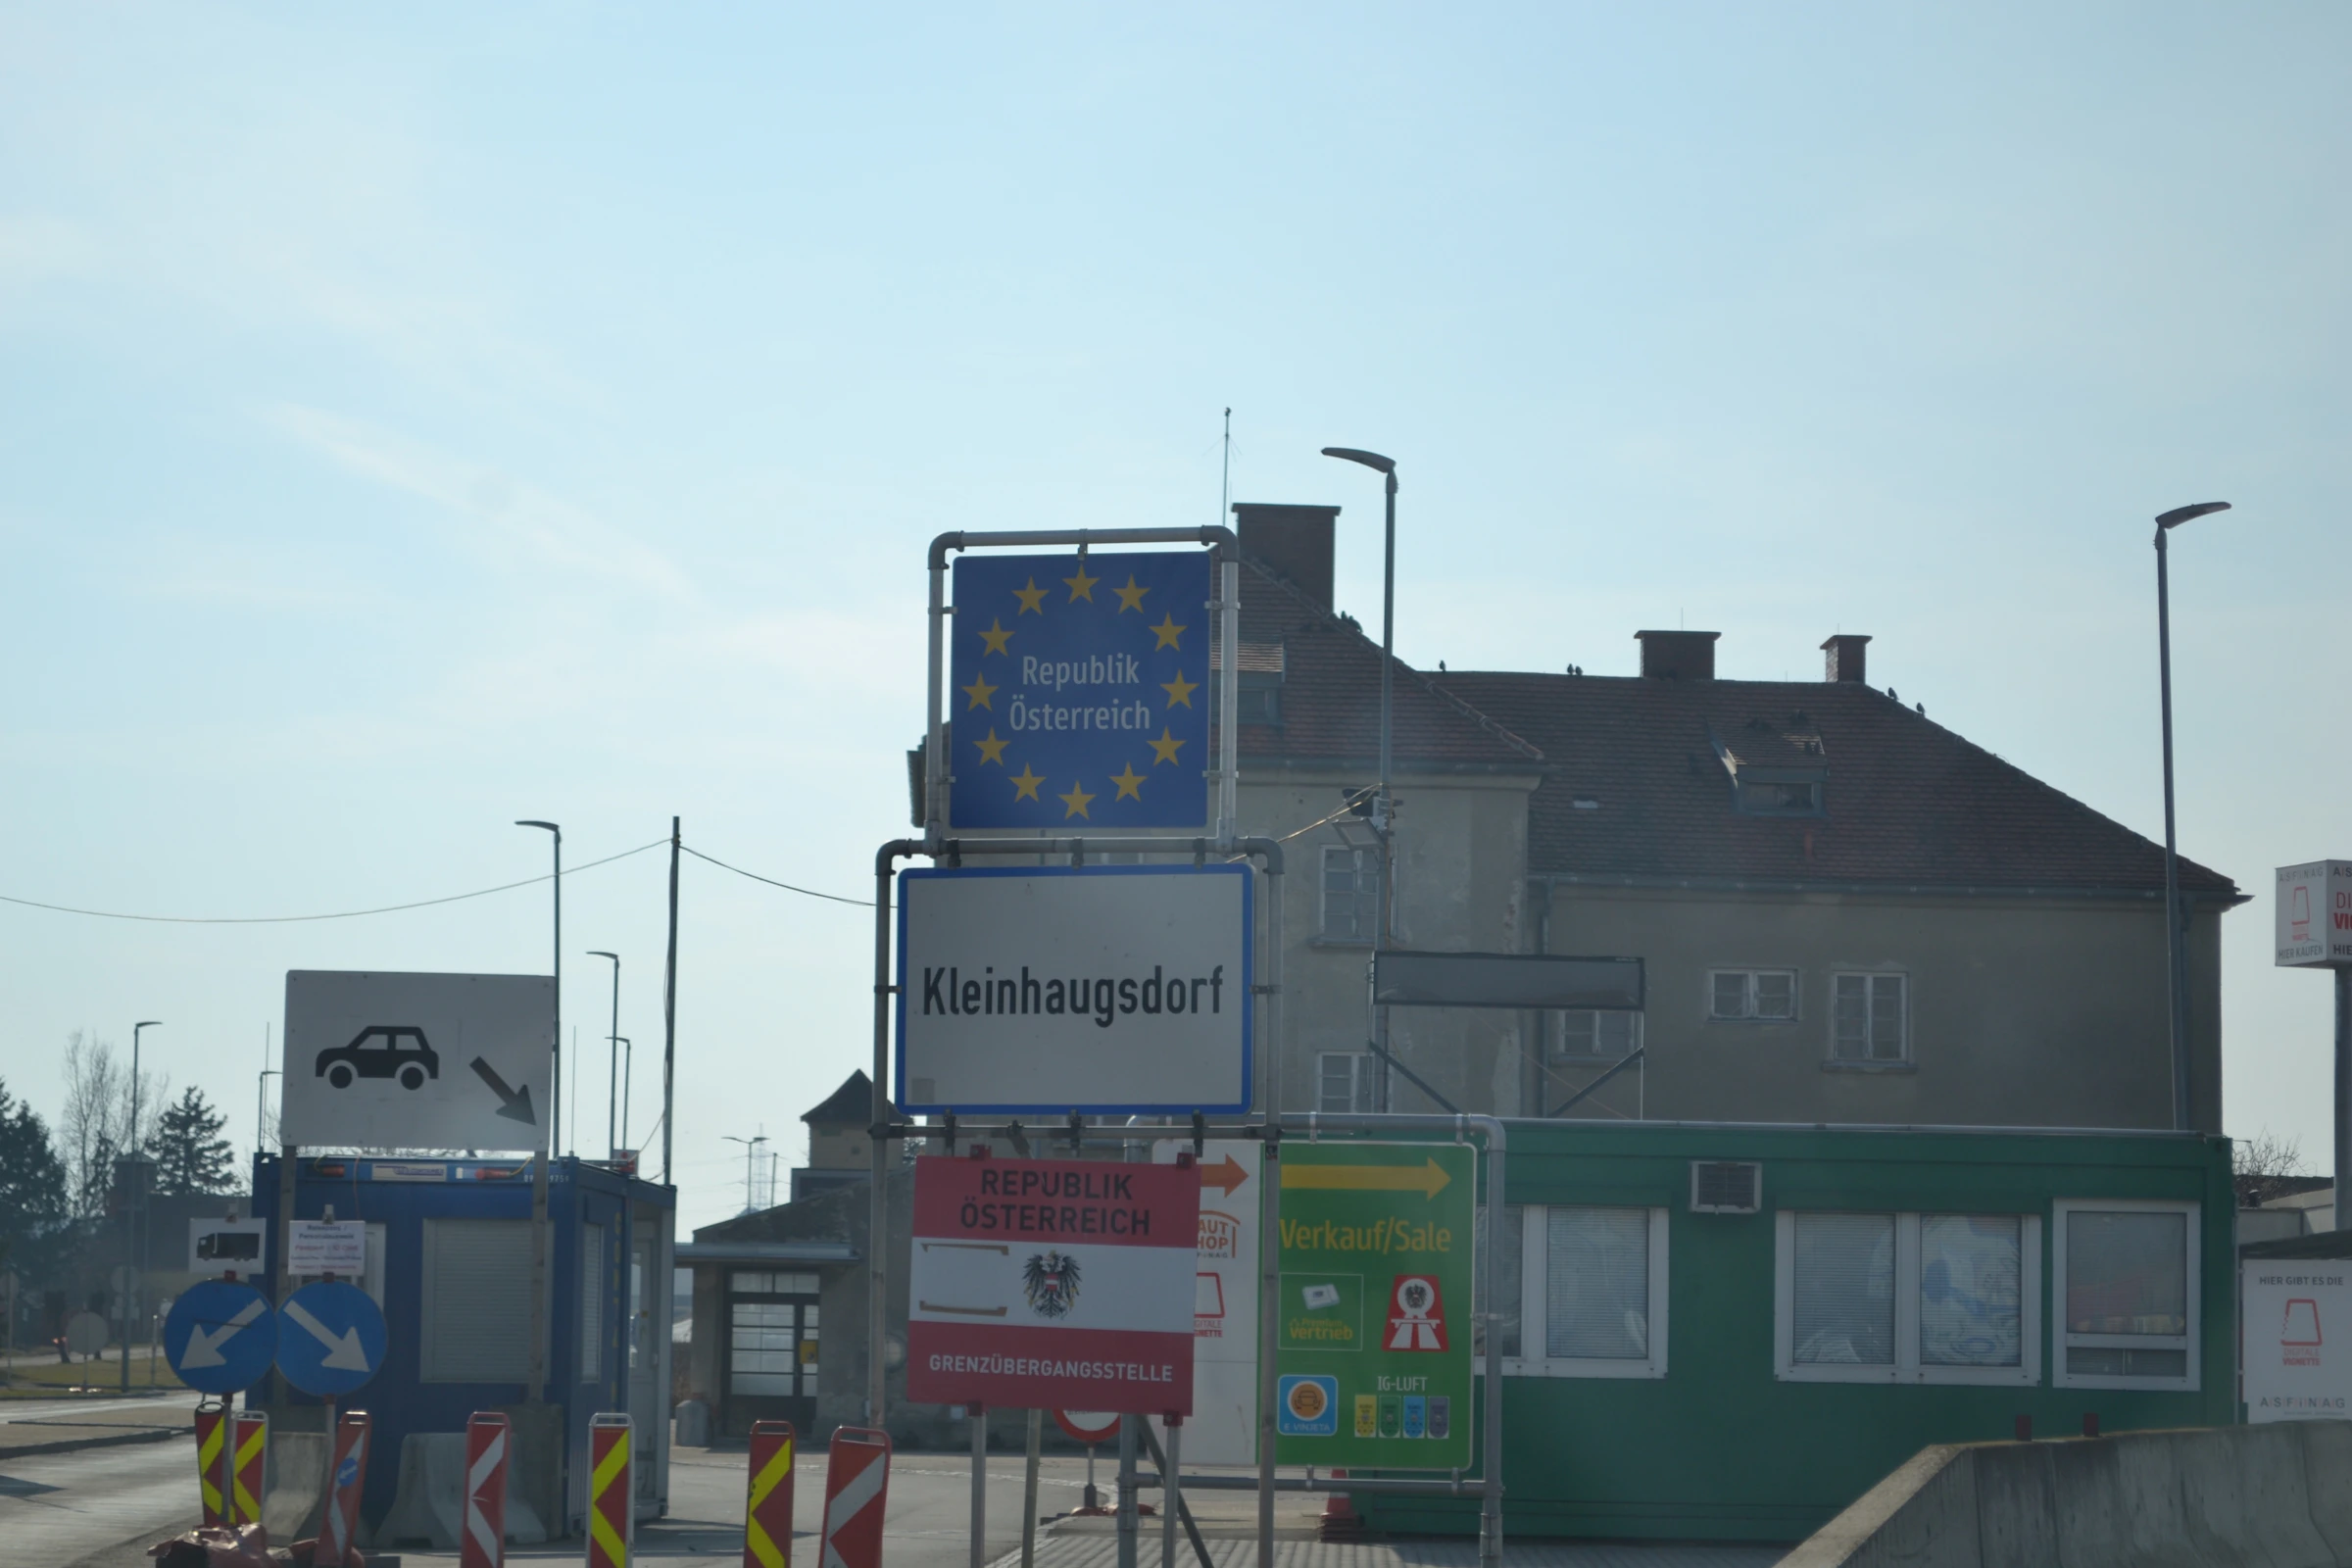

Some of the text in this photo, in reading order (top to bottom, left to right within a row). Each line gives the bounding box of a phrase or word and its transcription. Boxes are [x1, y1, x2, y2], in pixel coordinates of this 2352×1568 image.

[1022, 653, 1140, 692] Republik
[1009, 694, 1151, 731] Österreich
[2278, 944, 2324, 960] HIER KAUFEN
[923, 964, 1224, 1028] Kleinhaugsdorf
[981, 1169, 1133, 1200] REPUBLIK
[960, 1196, 1151, 1236] ÖSTERREICH
[1198, 1219, 1229, 1235] AUT
[1197, 1235, 1229, 1250] HOP
[1279, 1216, 1451, 1254] Verkauf/Sale
[2259, 1276, 2344, 1286] HIER GIBT ES DIE
[2282, 1357, 2321, 1366] VIGNETTE
[2283, 1348, 2321, 1356] DIGITALE
[929, 1353, 1173, 1383] GRENZÜBERGANGSSTELLE
[1377, 1375, 1428, 1392] IG-LUFT
